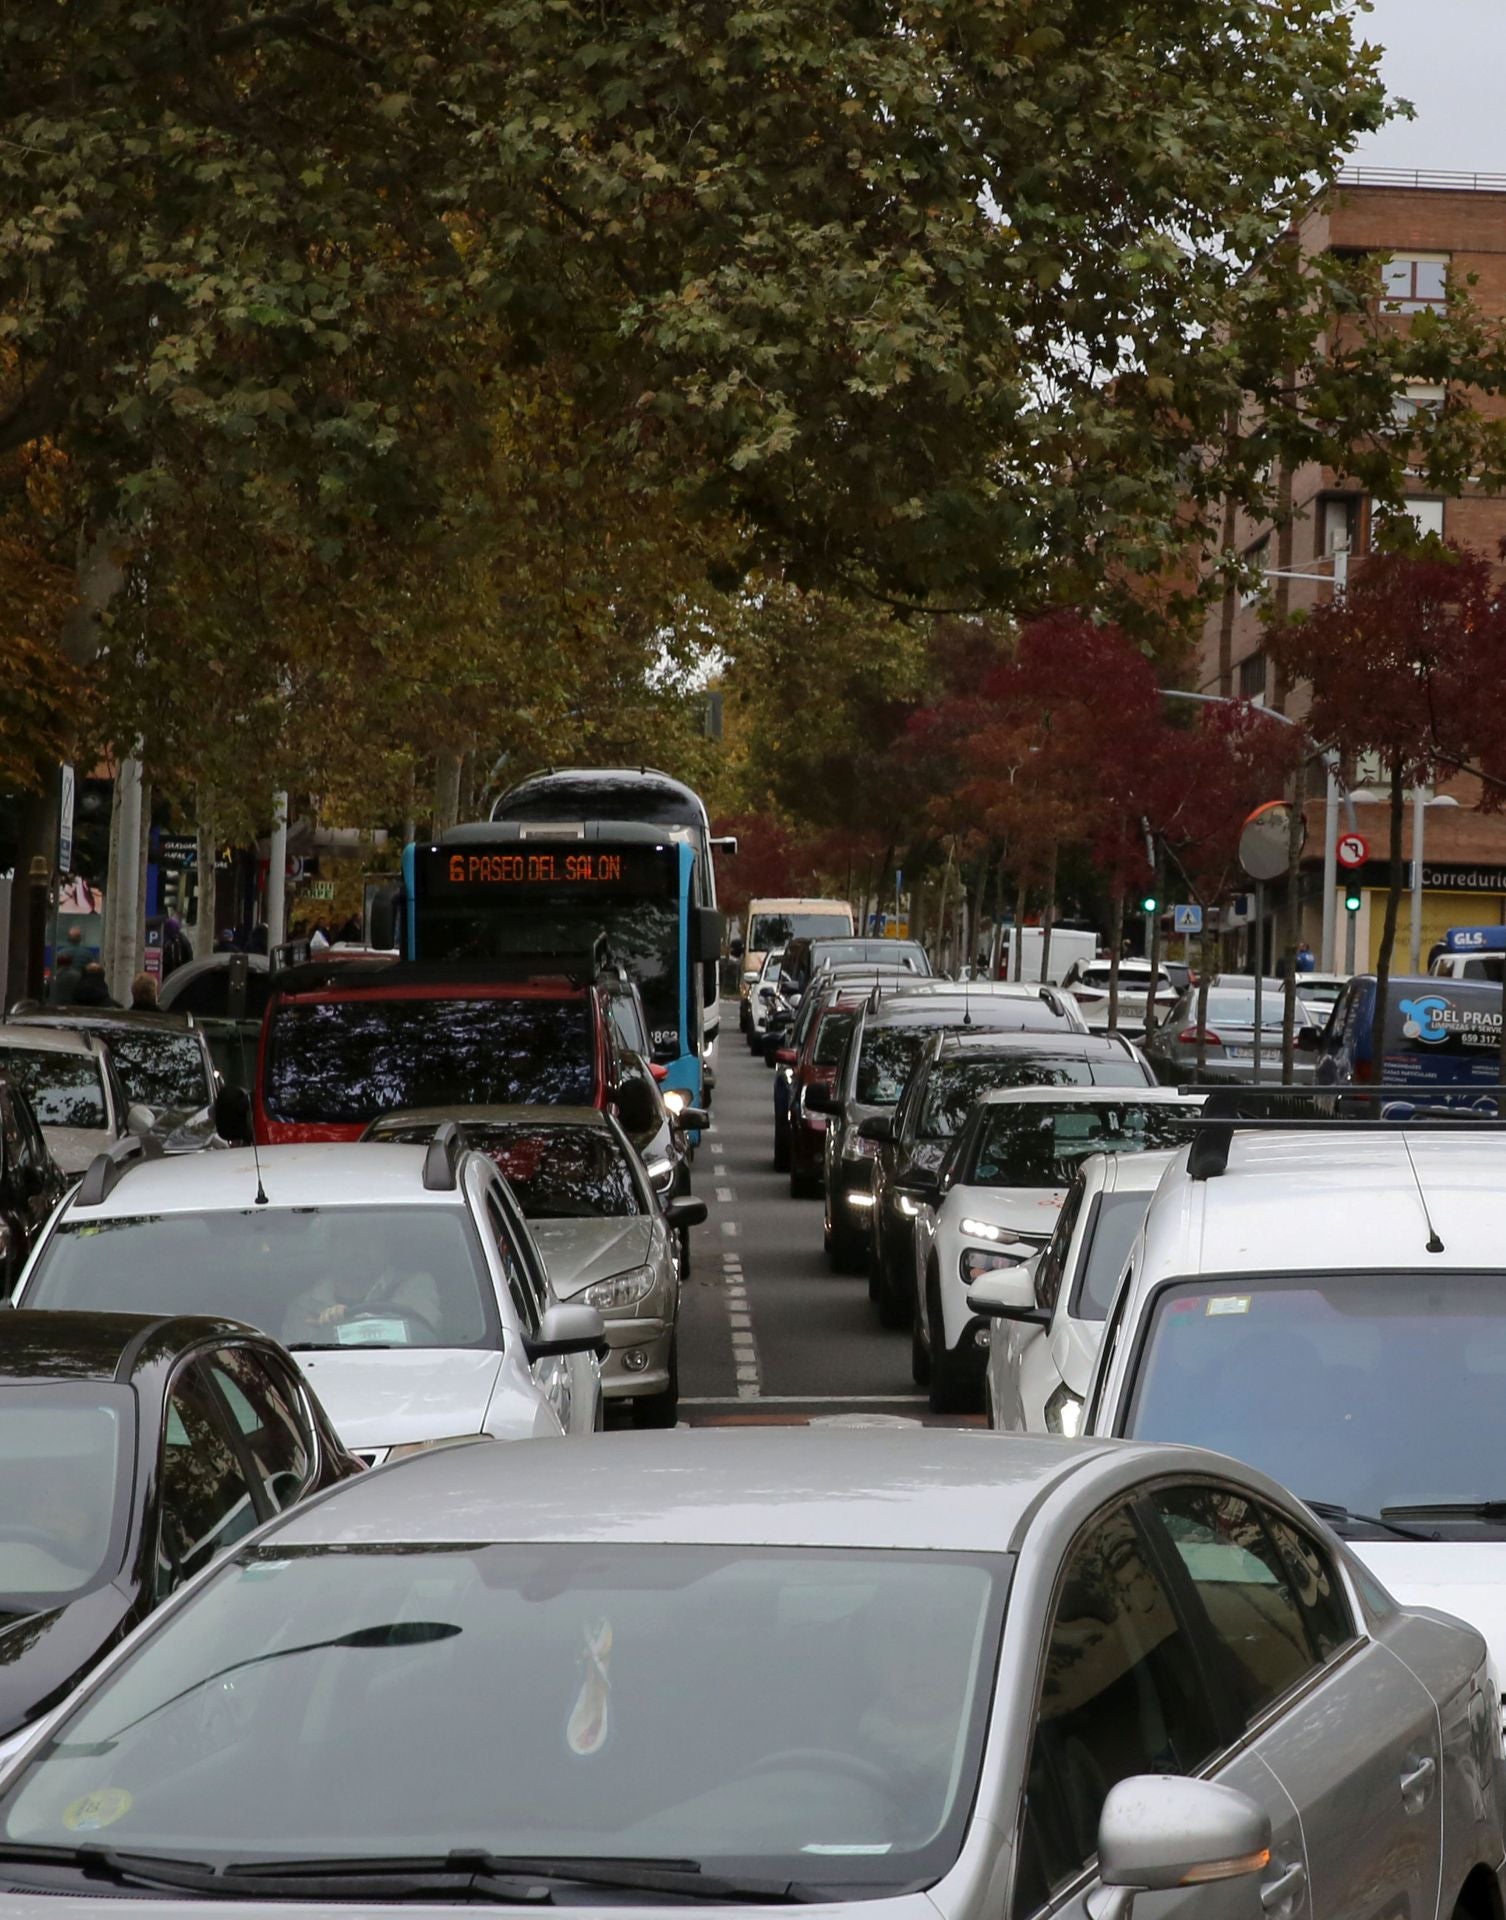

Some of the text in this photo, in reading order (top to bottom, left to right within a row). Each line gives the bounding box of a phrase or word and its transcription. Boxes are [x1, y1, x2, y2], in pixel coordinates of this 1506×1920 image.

[449, 855, 621, 881] 6 PASEO DEL SALON
[149, 931, 158, 943] P
[1432, 1009, 1503, 1026] DEL PRAD
[1461, 1033, 1478, 1042] 659
